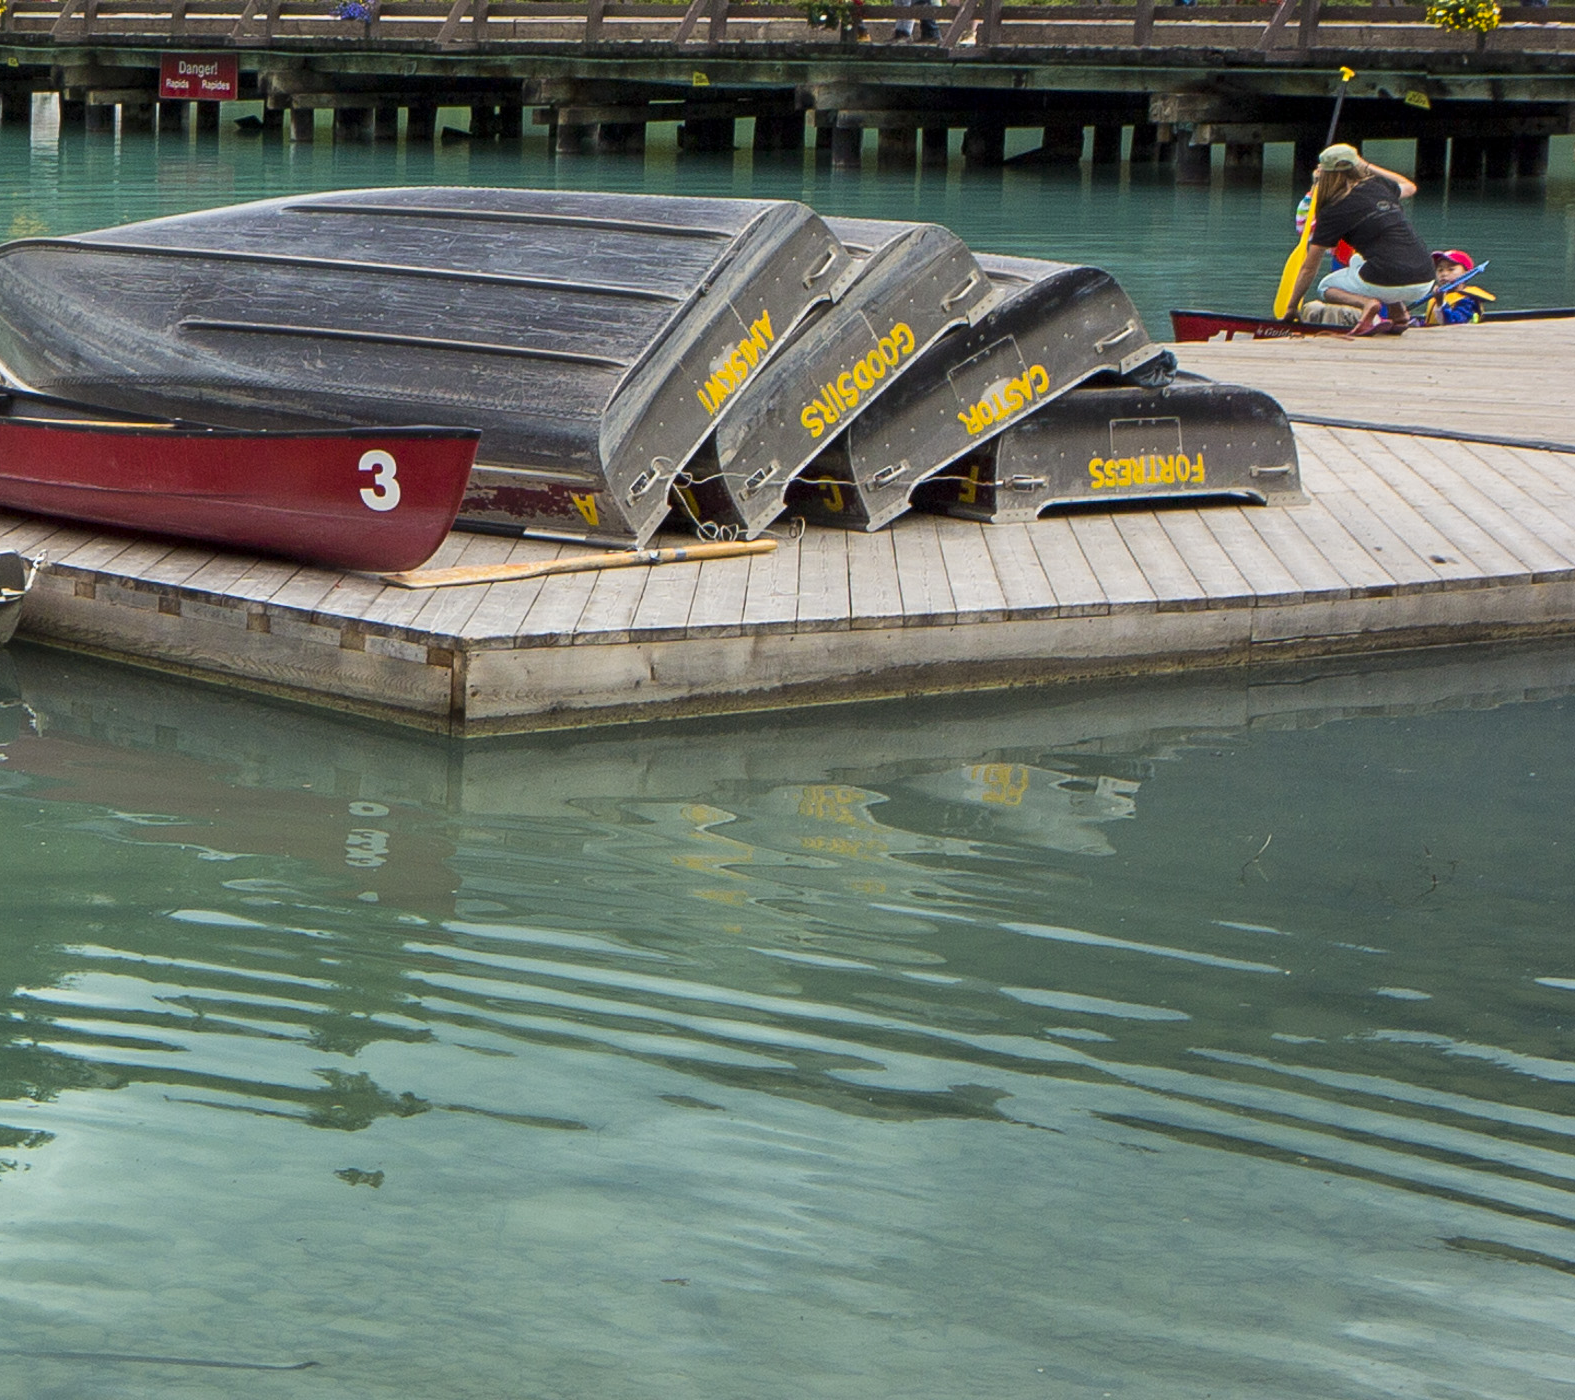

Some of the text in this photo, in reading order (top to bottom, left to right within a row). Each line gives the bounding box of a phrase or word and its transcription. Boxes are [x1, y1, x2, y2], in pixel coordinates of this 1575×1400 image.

[166, 78, 190, 90] Rapids
[179, 61, 218, 78] Danger!
[201, 80, 231, 91] Rapides
[697, 309, 774, 415] AMISKWI
[800, 322, 915, 438] GOODSIRS
[958, 365, 1049, 435] CASTOR
[358, 449, 401, 511] 3
[1089, 453, 1205, 489] FORTRESS
[569, 489, 600, 526] A
